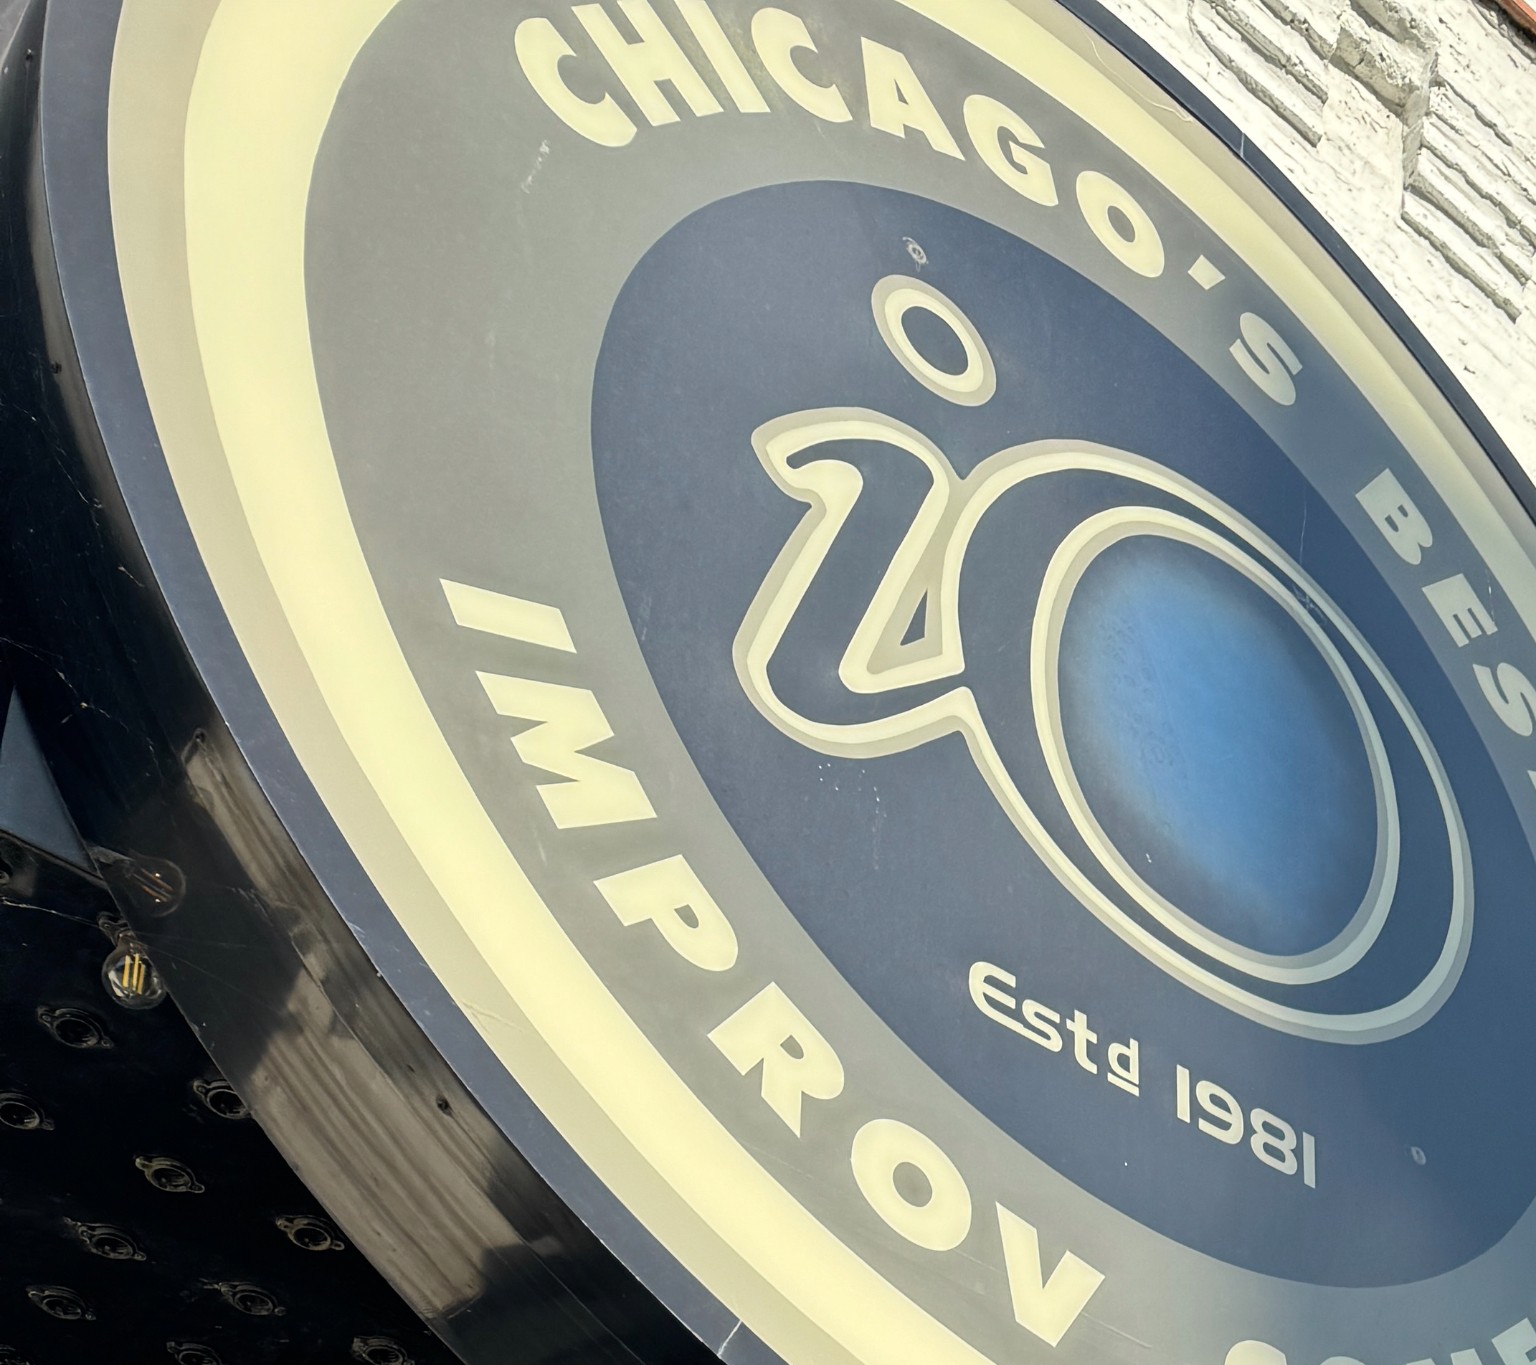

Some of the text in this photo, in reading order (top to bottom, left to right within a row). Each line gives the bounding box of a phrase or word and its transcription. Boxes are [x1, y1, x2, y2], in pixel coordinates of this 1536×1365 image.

[514, 0, 1302, 407] CHICAGO'S
[438, 578, 1105, 1348] IMPROV
[968, 961, 1316, 1189] Estd 1981
